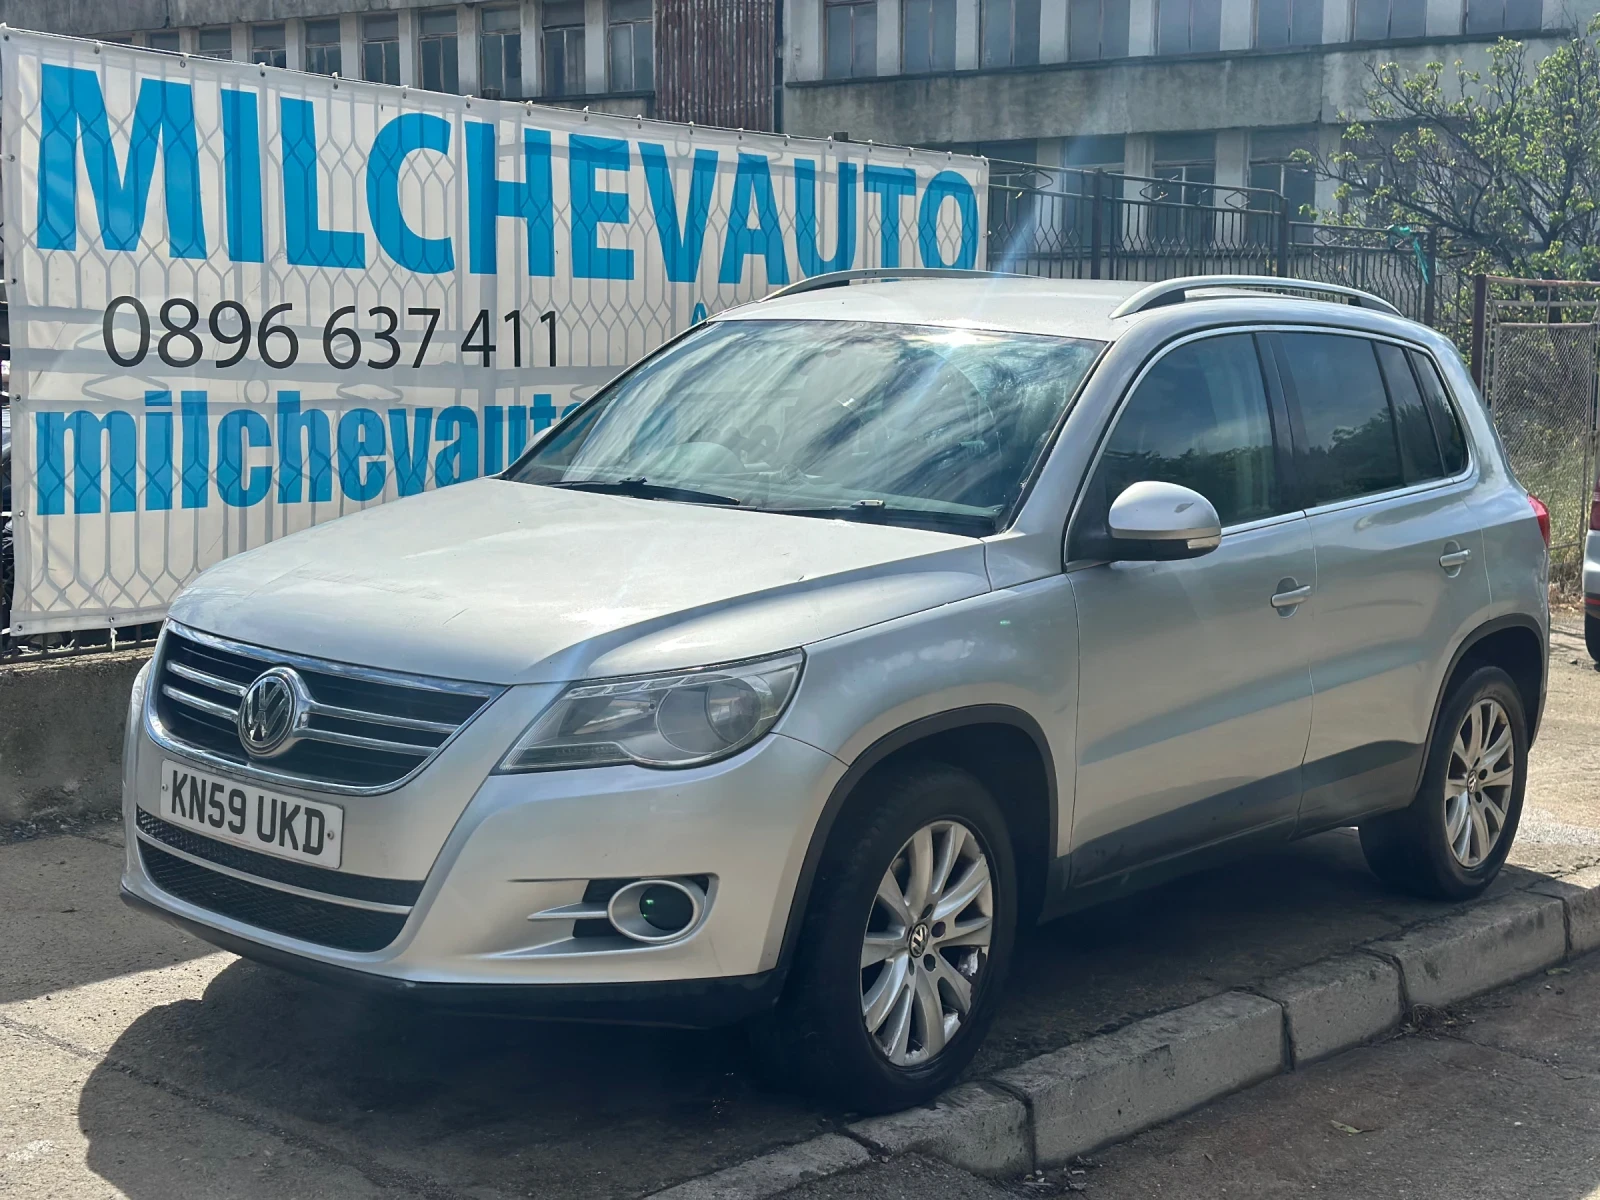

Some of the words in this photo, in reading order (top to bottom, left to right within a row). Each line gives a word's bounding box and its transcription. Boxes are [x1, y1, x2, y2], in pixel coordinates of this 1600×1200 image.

[37, 63, 979, 285] MILCHEVAUTO
[102, 296, 299, 369] 0896
[322, 305, 441, 370] 637
[461, 309, 557, 369] 411
[36, 390, 582, 516] milchevaut
[171, 769, 247, 836] KN59
[256, 795, 326, 857] UKD
